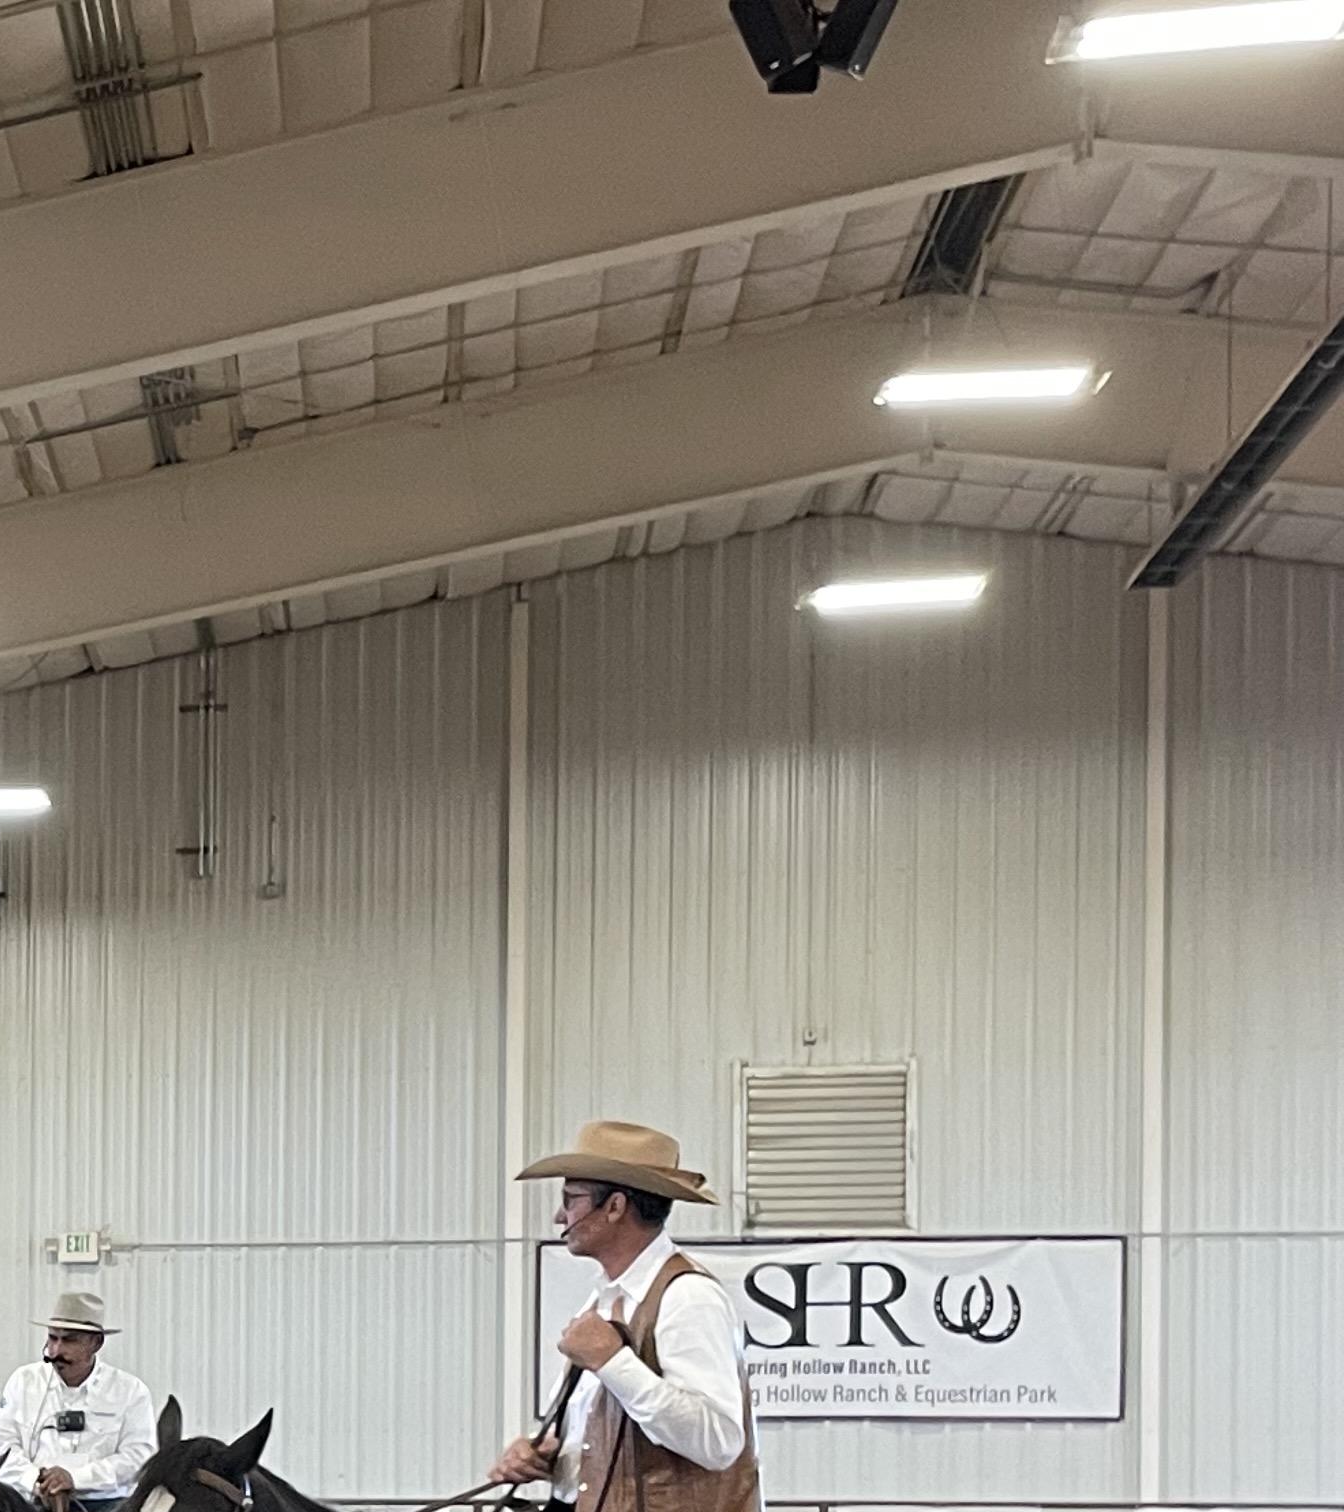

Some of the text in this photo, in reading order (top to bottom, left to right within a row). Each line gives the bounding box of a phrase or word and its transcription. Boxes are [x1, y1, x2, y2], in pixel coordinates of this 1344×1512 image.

[66, 1235, 90, 1253] EXIT
[743, 1262, 926, 1349] SHR
[747, 1359, 931, 1378] pring Hollow Ranch, LLC
[767, 1384, 828, 1403] Hollow
[833, 1384, 889, 1403] Ranch
[895, 1384, 908, 1403] &
[914, 1384, 1011, 1408] Equestrian
[1017, 1384, 1058, 1404] Park
